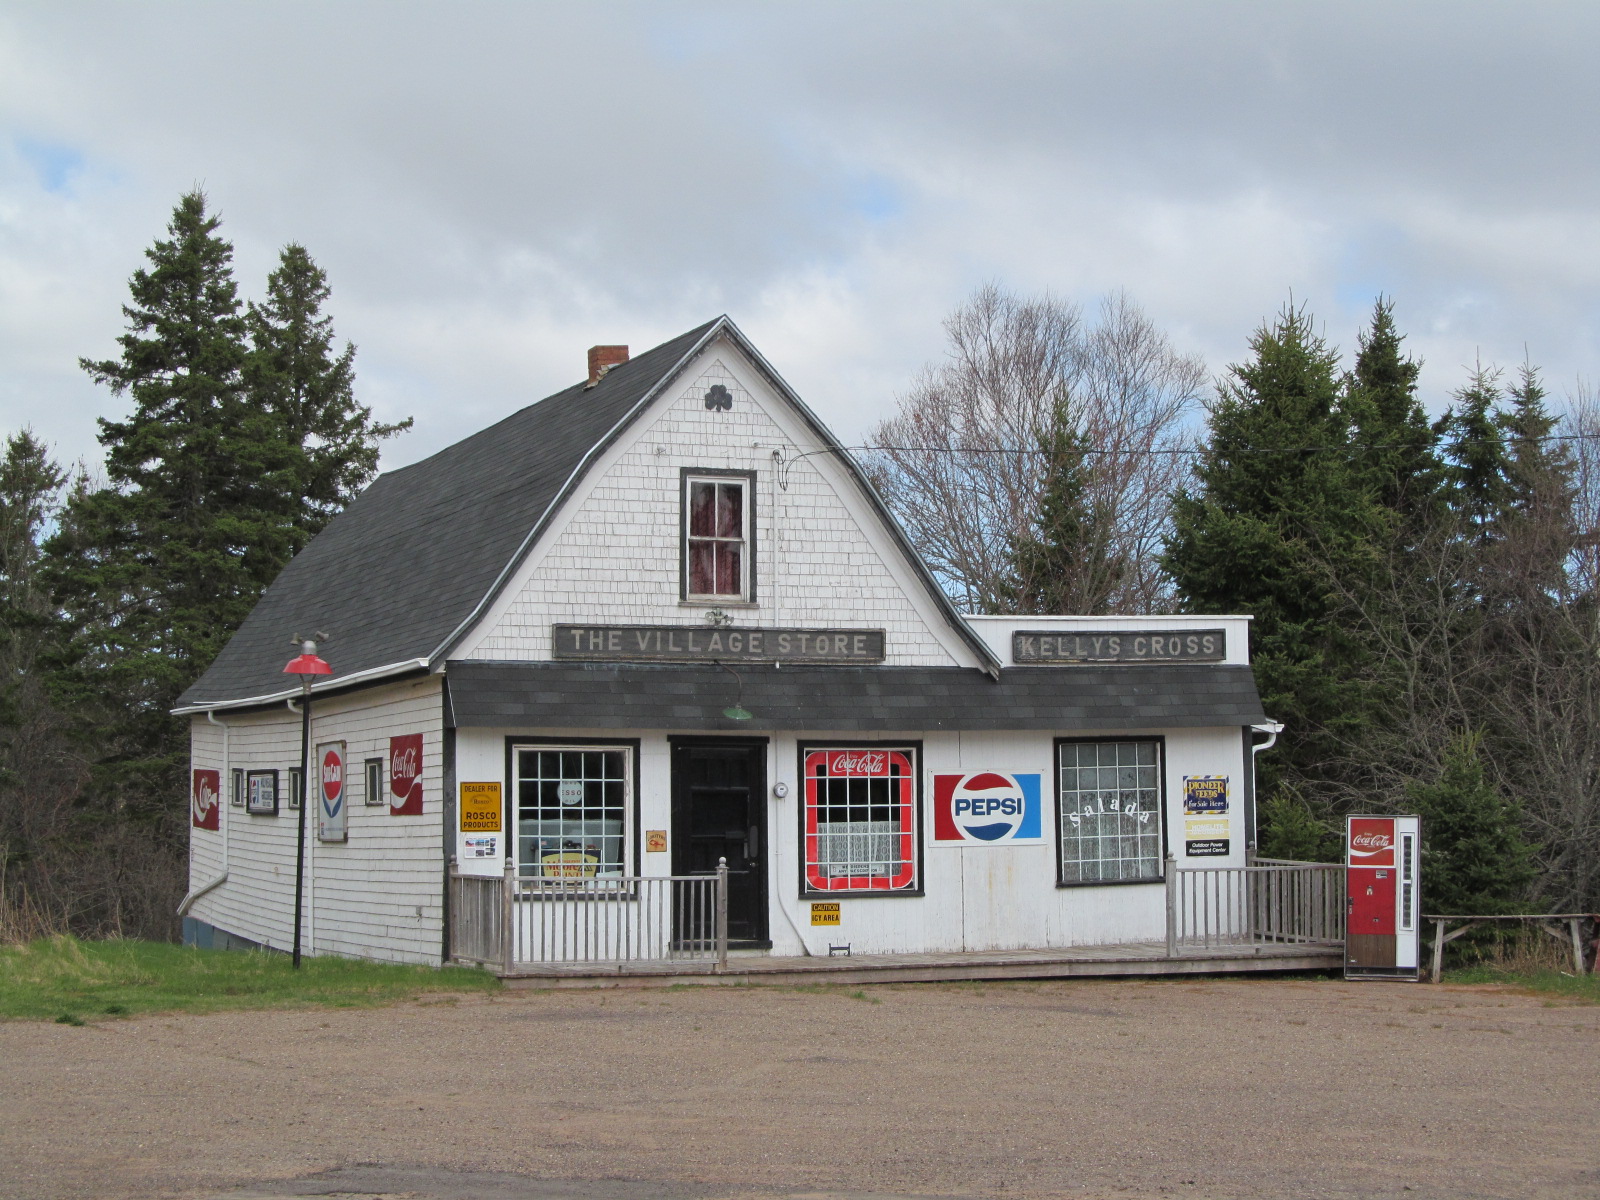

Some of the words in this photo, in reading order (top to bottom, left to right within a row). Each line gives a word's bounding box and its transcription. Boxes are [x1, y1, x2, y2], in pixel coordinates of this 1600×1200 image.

[570, 630, 622, 651] THE
[636, 631, 763, 653] VILLAGE
[778, 633, 867, 655] STORE
[1020, 636, 1121, 656] KELLYS
[1134, 635, 1215, 656] CROSS
[832, 753, 885, 773] Coca-Cola
[1188, 781, 1225, 794] PIONEER
[1195, 789, 1218, 798] FEEDS
[955, 798, 1022, 816] PEPSI
[1188, 800, 1197, 808] For
[1197, 800, 1208, 808] Sale
[466, 812, 497, 820] ROSCO
[1069, 797, 1149, 828] Salada
[1353, 834, 1390, 847] Coca-Cola
